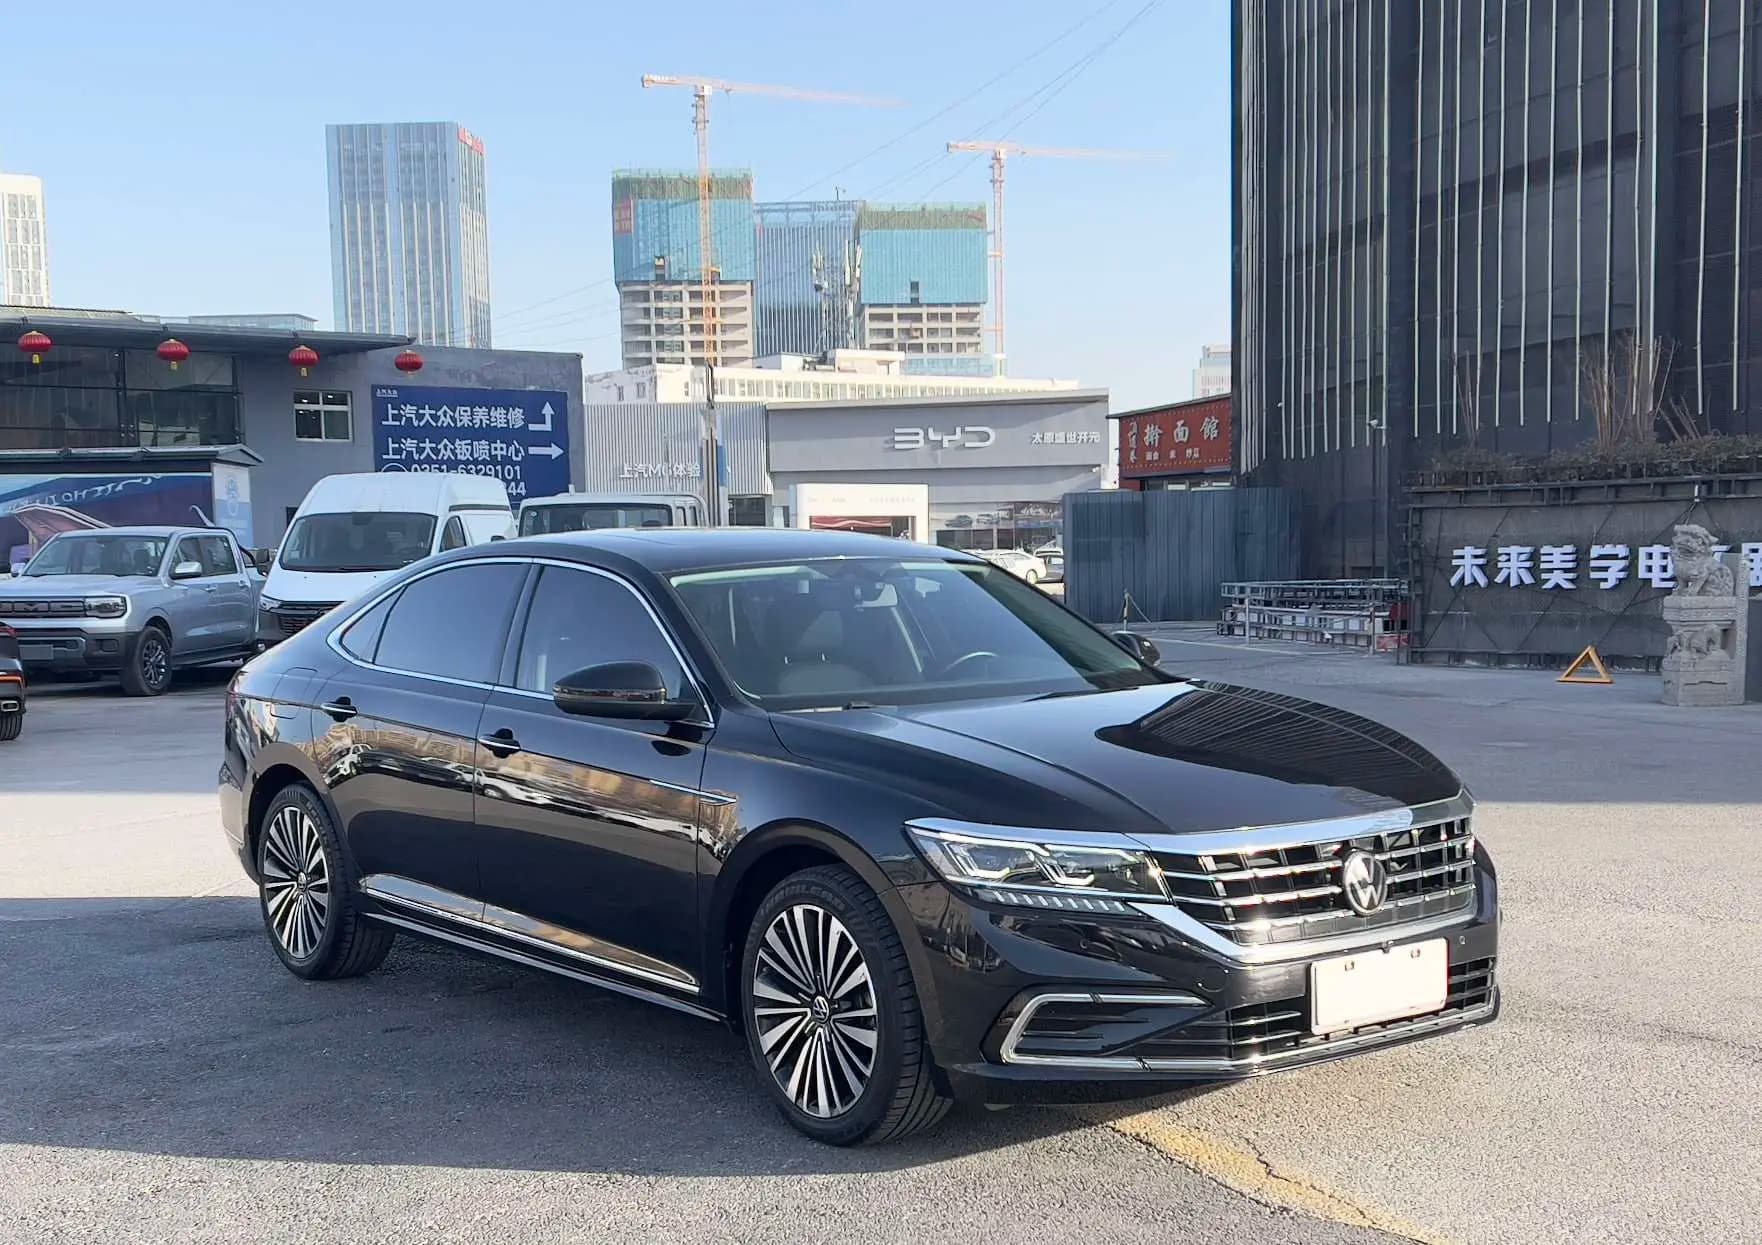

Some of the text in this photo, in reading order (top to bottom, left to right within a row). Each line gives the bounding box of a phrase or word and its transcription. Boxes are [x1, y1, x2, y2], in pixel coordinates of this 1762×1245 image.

[382, 403, 525, 429] 上汽大众保养维修
[382, 437, 525, 462] 上汽大众钣喷中心
[894, 426, 997, 450] BYD
